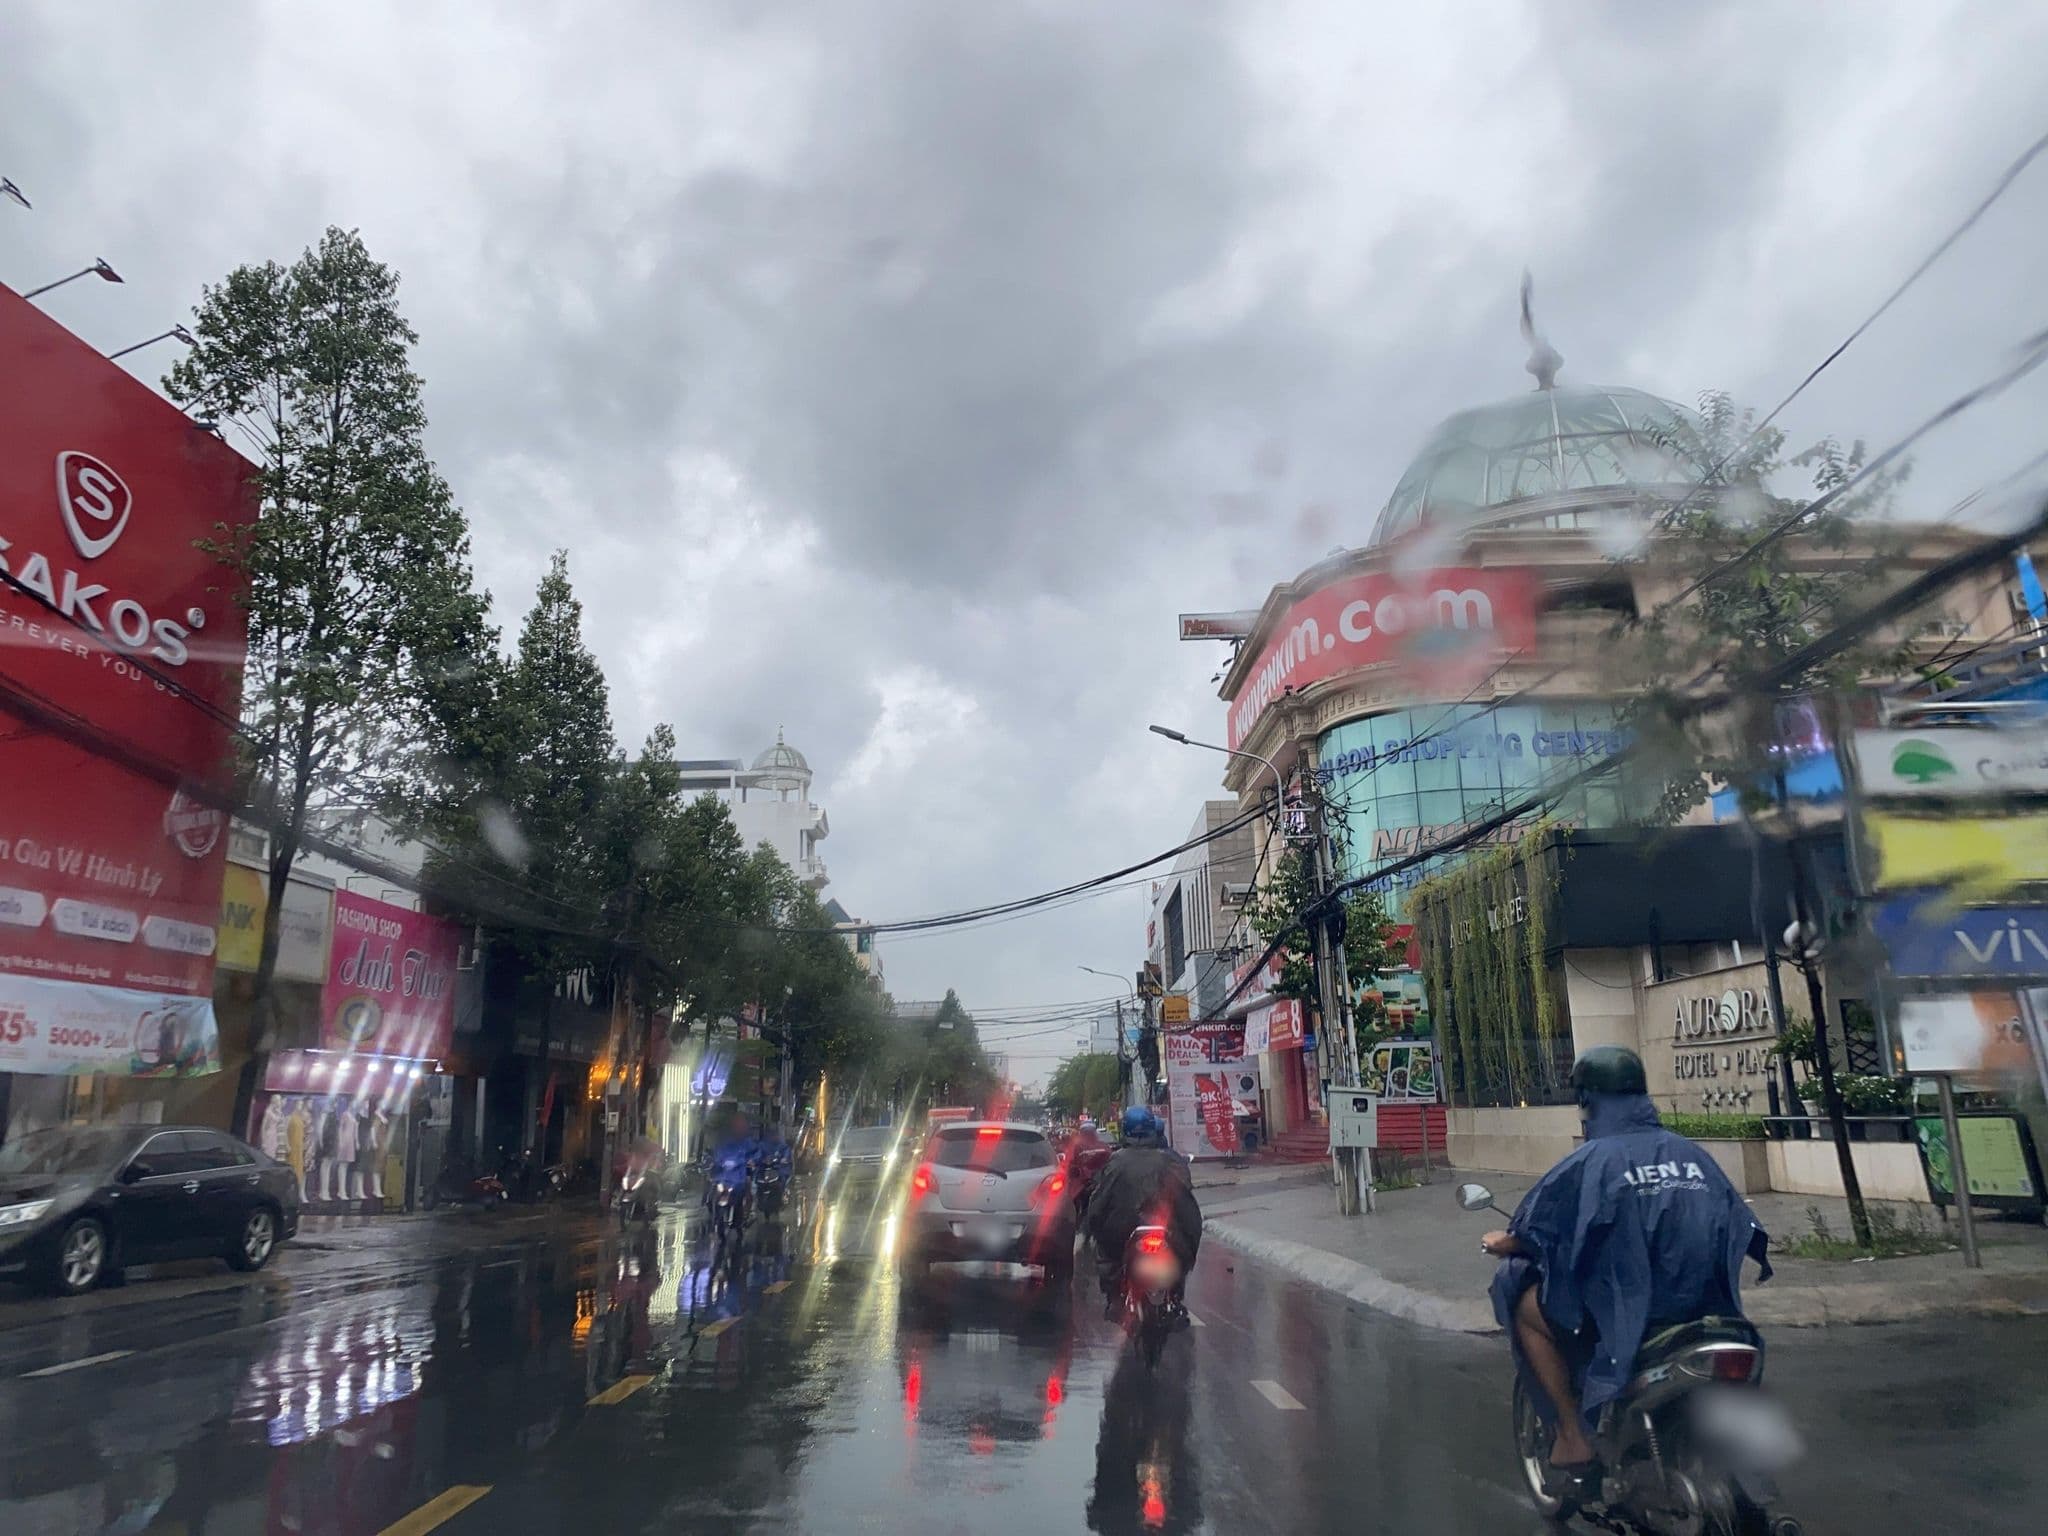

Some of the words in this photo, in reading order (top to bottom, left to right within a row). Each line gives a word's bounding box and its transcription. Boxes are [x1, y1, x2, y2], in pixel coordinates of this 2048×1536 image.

[100, 655, 142, 681] YOU
[337, 907, 378, 935] FASHION
[379, 918, 403, 941] SHOP
[340, 937, 396, 993] Anh
[1674, 988, 1775, 1037] AURORA
[1674, 1052, 1717, 1080] HOTEL
[1737, 1046, 1781, 1075] PLAZA
